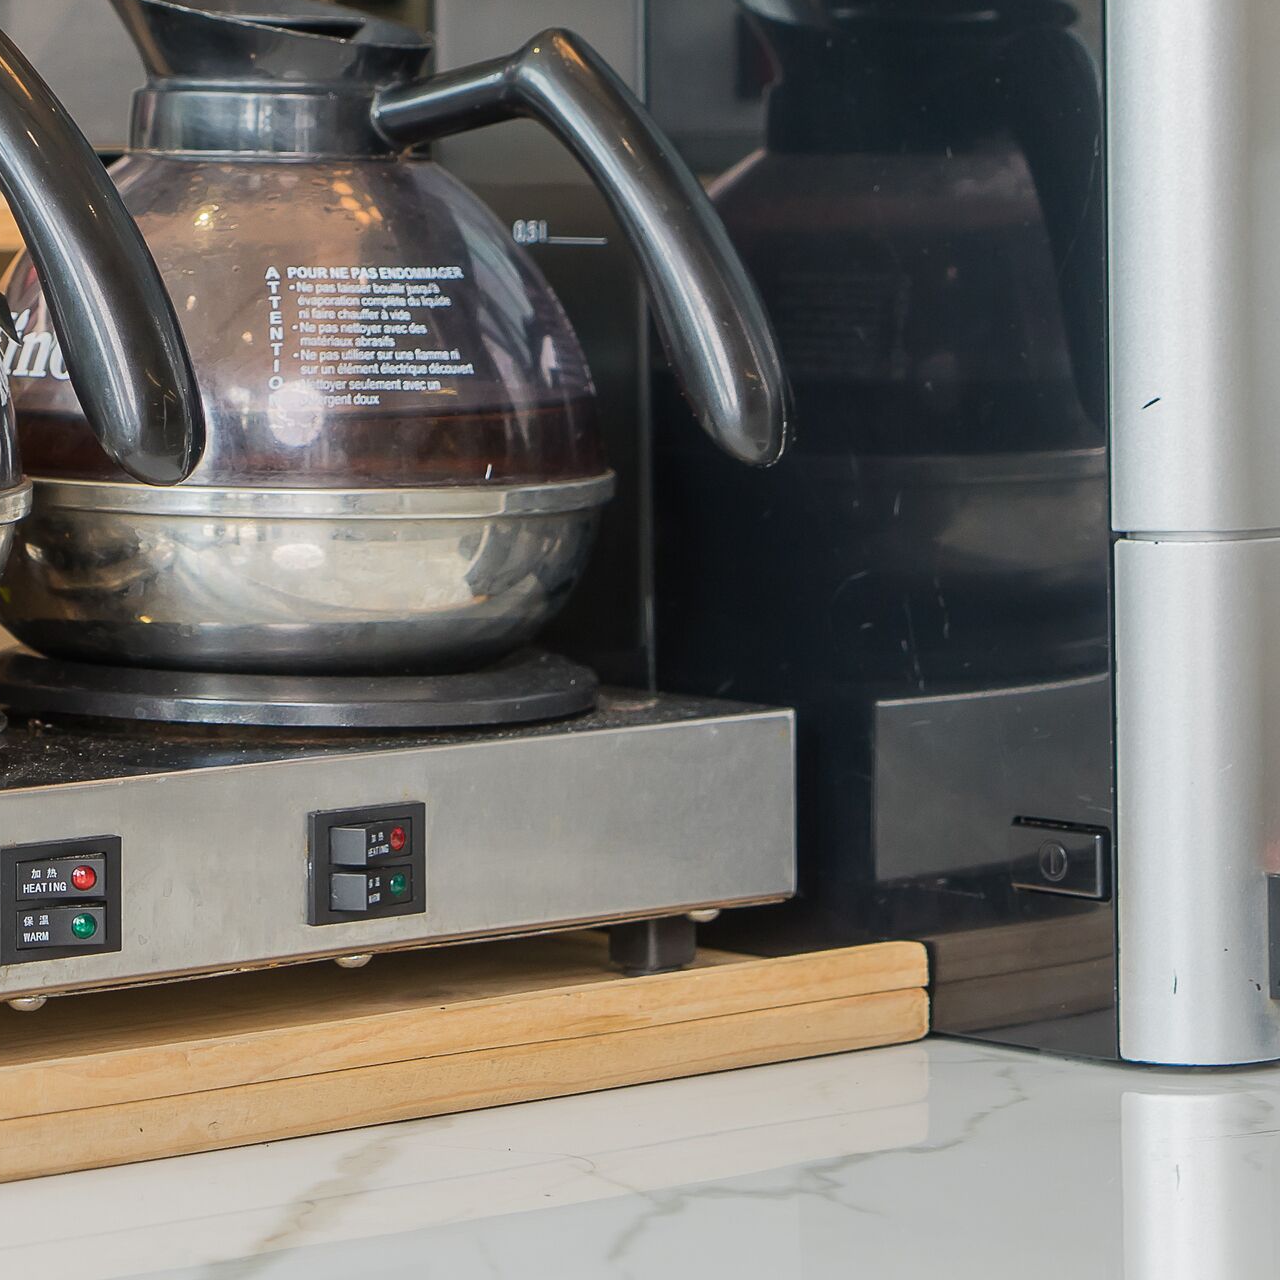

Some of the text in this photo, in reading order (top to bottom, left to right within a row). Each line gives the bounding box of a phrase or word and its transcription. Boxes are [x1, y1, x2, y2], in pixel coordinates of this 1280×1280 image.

[287, 267, 329, 279] POUR
[330, 267, 349, 279] NE
[351, 267, 378, 279] PAS
[296, 282, 314, 292] Ne
[316, 284, 336, 294] pas
[299, 309, 310, 319] ni
[312, 309, 336, 319] faire
[390, 310, 411, 321] vide
[300, 323, 316, 333] Ne
[319, 325, 338, 334] pas
[383, 324, 408, 334] avec
[409, 323, 427, 334] des
[300, 350, 317, 360] Ne
[320, 352, 339, 362] pas
[377, 351, 393, 360] sur
[395, 351, 414, 360] une
[301, 365, 318, 375] sur
[321, 365, 335, 374] un
[349, 379, 401, 390] seulement
[403, 380, 427, 390] avec
[428, 380, 441, 390] un
[353, 394, 380, 405] doux
[31, 868, 58, 879] 加热
[23, 882, 67, 893] HEATING
[24, 915, 49, 927] 保温
[24, 932, 49, 942] WARM
